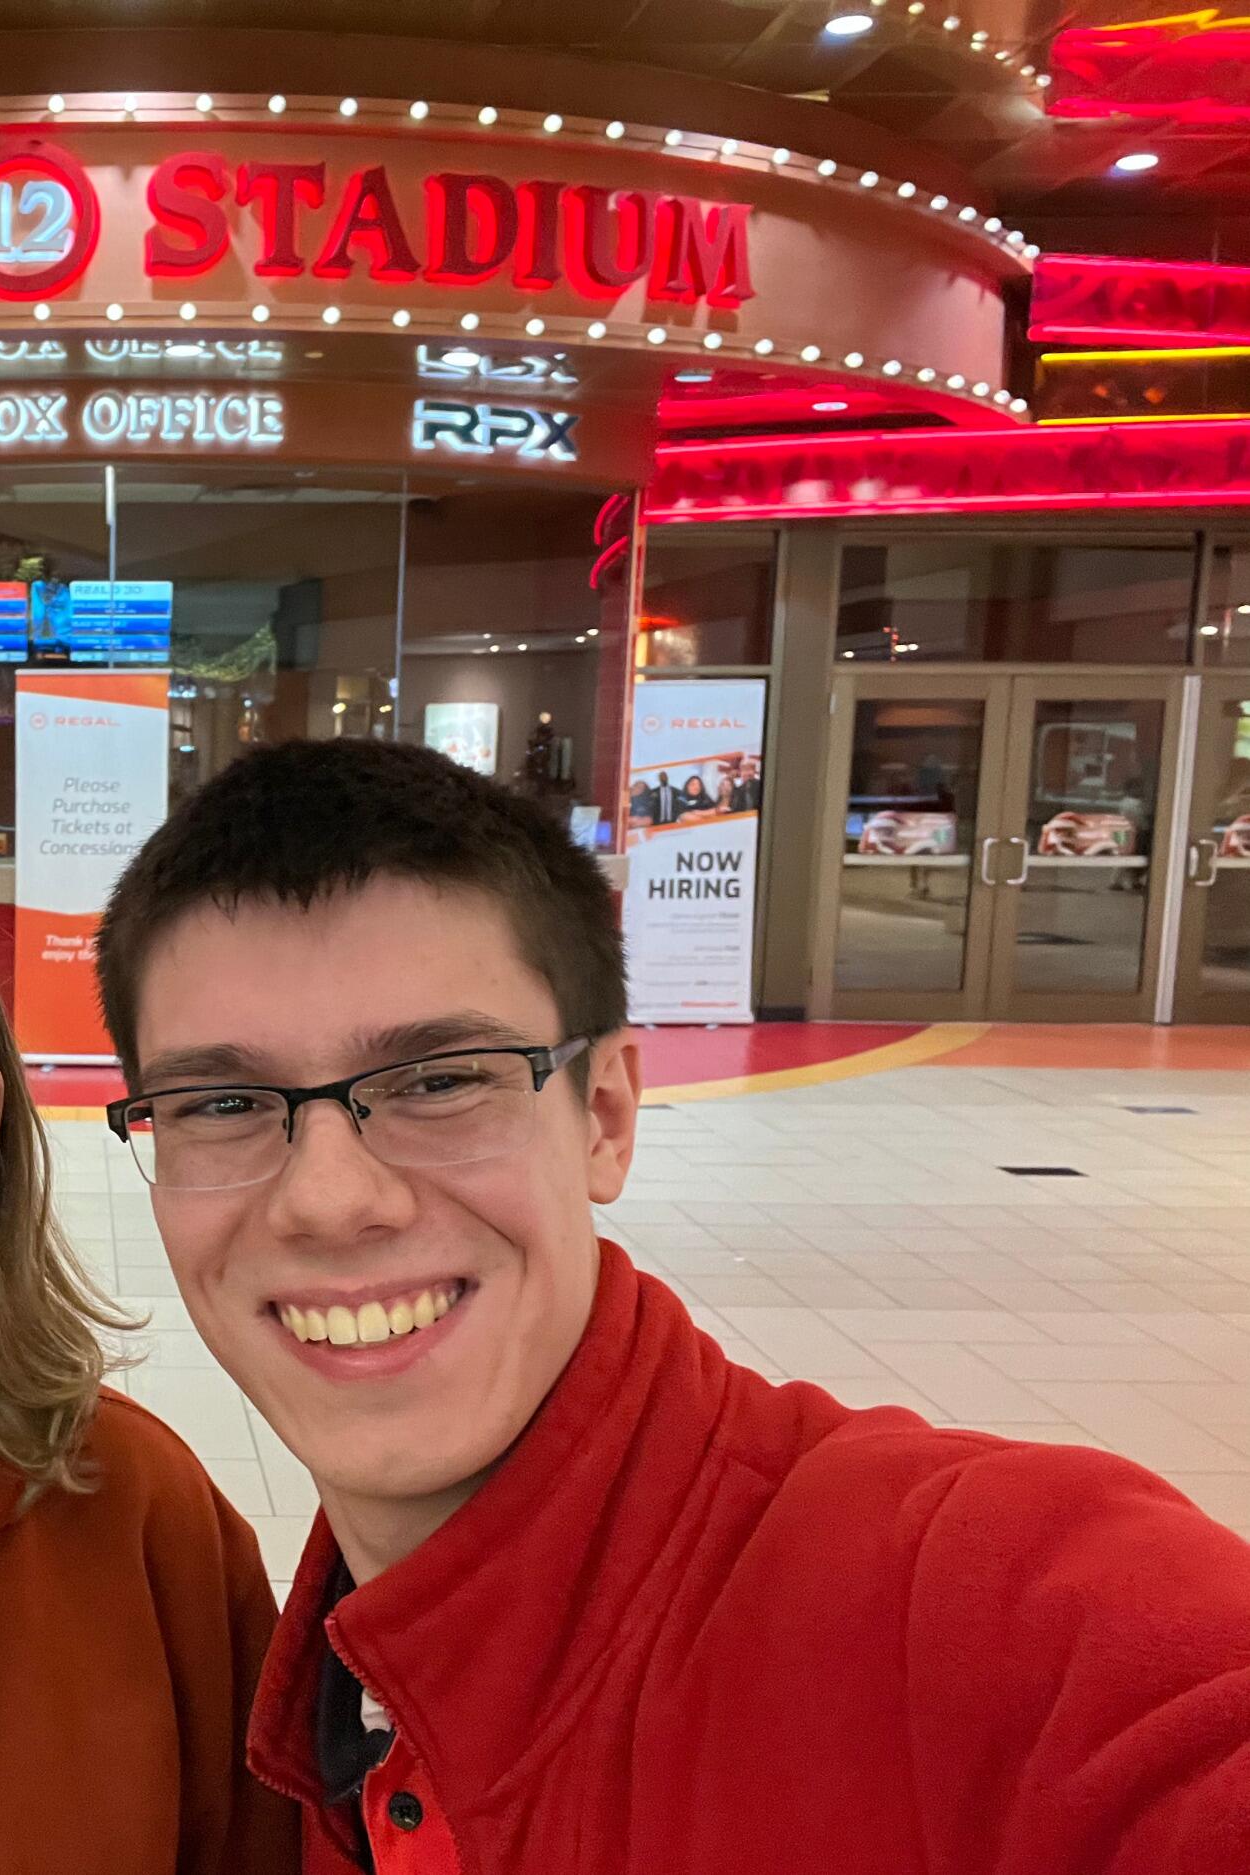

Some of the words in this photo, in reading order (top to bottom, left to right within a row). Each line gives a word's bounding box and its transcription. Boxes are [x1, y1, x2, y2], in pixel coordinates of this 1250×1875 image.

[145, 150, 755, 308] STADIUM
[82, 390, 284, 442] OFFICE
[412, 399, 579, 461] RPX
[54, 716, 121, 727] REGAL
[670, 717, 747, 729] REGAL
[63, 777, 120, 793] Please
[52, 798, 130, 814] Purchase
[51, 818, 109, 835] Tickets
[114, 820, 132, 835] at
[675, 851, 742, 873] NOW
[648, 877, 741, 899] HIRING
